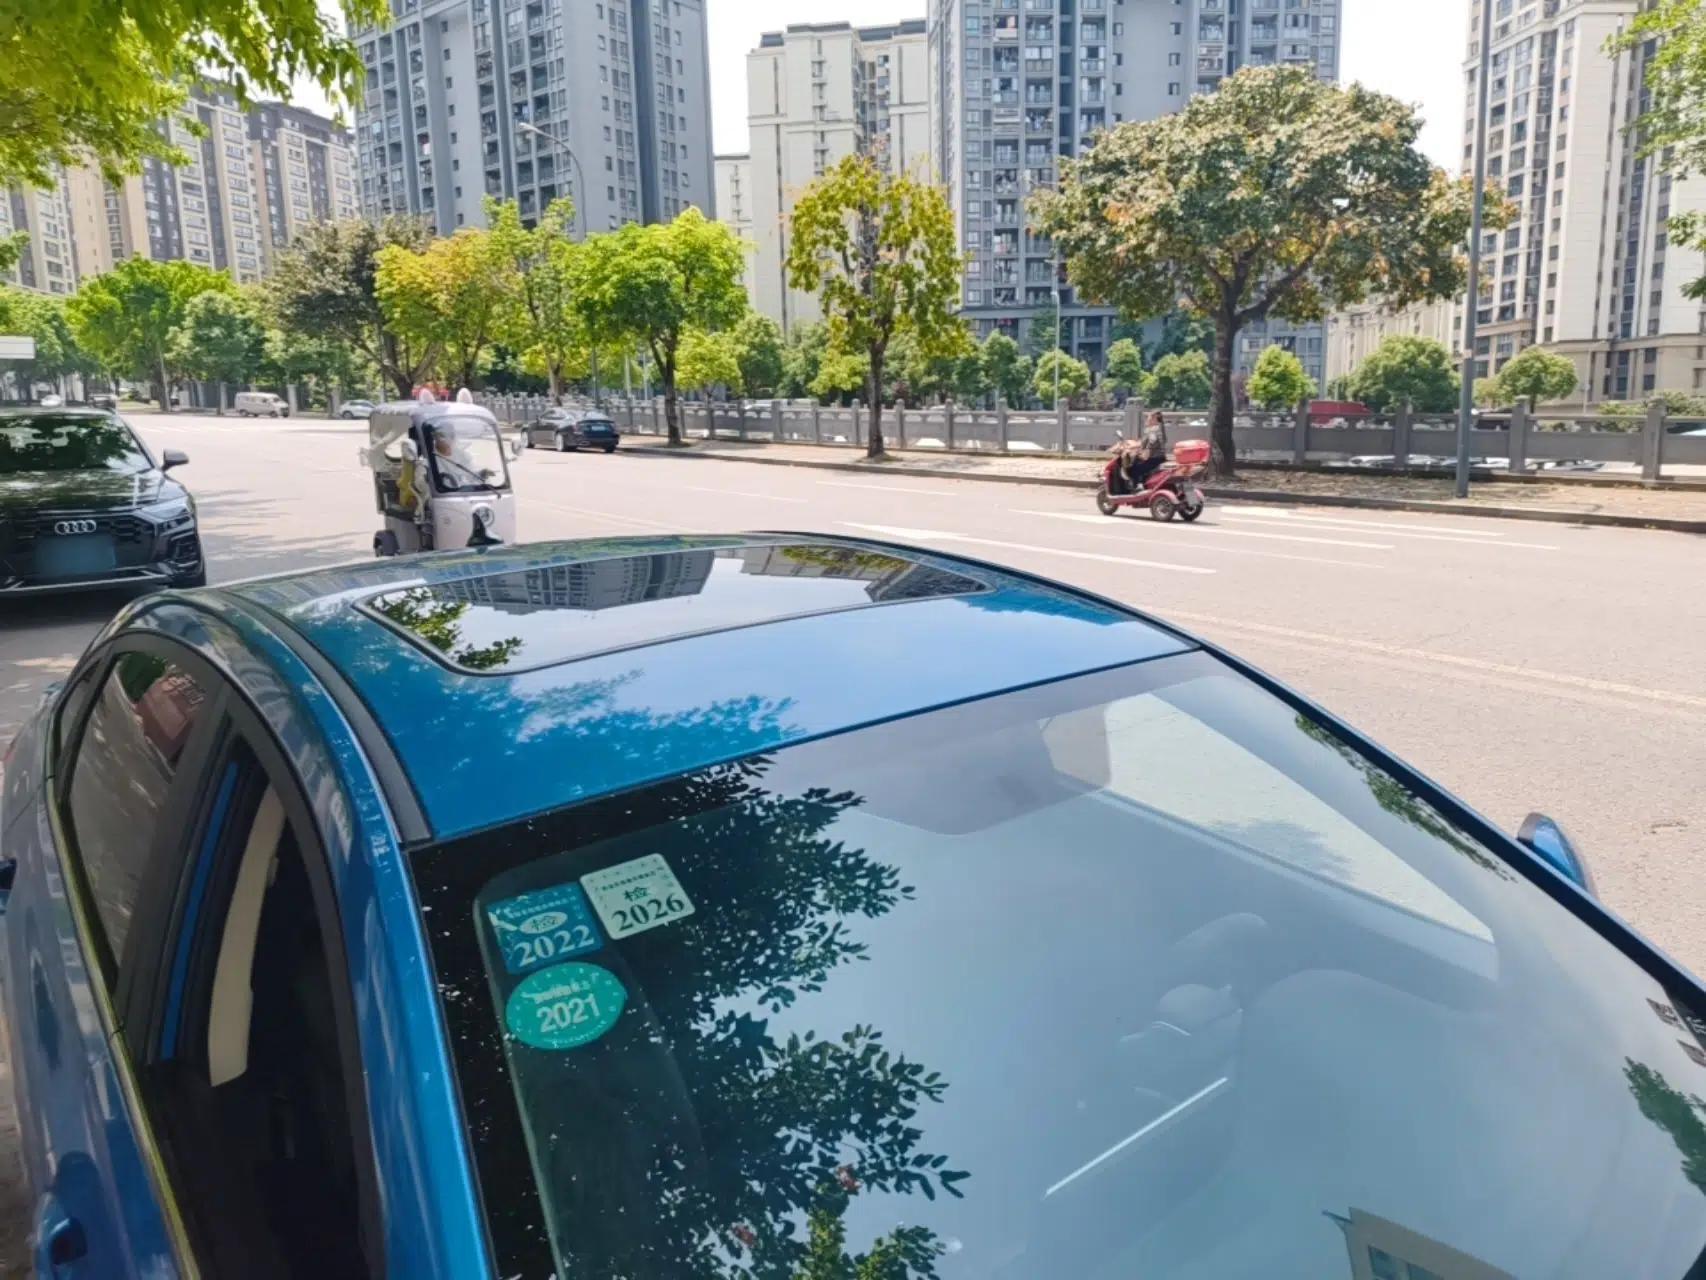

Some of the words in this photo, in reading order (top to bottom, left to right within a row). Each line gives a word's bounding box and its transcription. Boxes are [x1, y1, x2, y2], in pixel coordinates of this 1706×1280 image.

[611, 893, 684, 932] 2026
[624, 886, 649, 902] 检
[513, 925, 594, 968] 2022
[536, 993, 600, 1032] 2021
